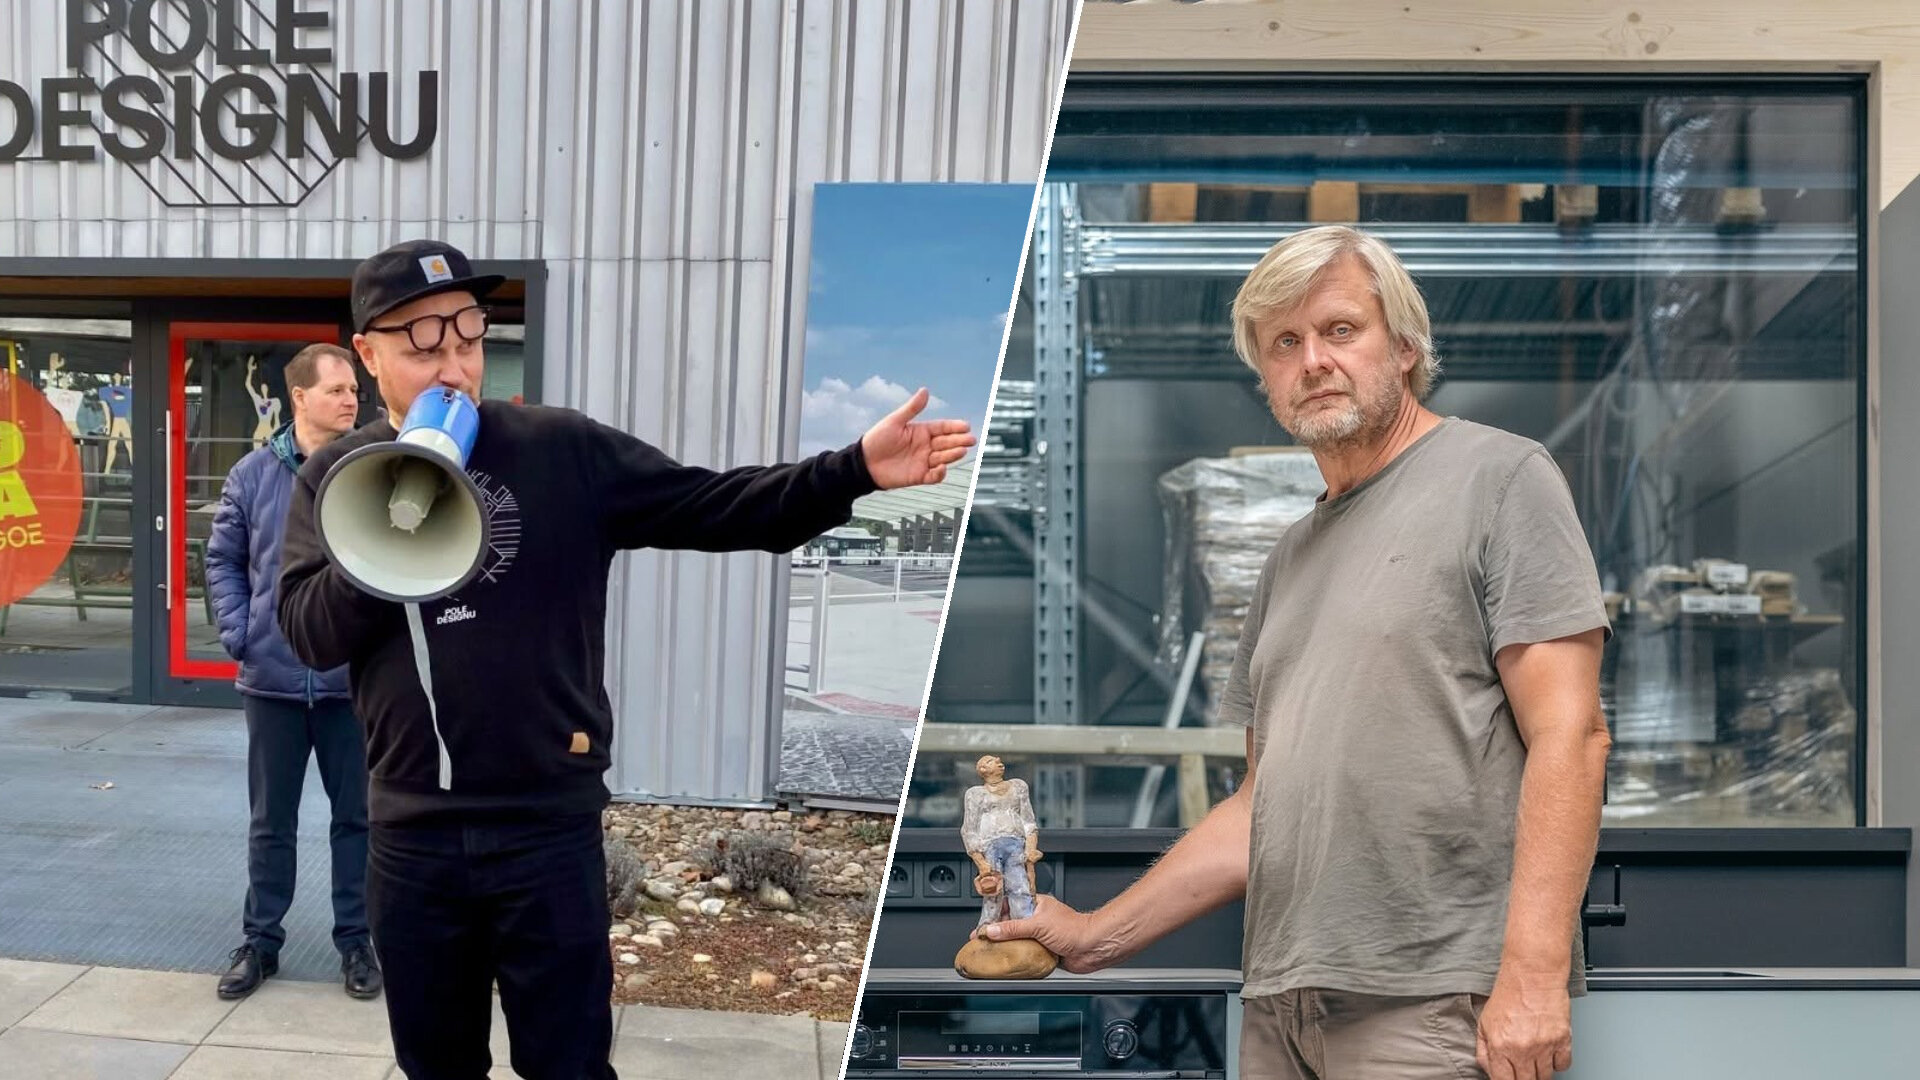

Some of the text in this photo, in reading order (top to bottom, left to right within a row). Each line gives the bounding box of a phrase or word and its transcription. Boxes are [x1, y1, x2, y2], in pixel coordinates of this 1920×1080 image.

[66, 0, 332, 70] POLE
[436, 609, 477, 625] DESIGNU
[444, 605, 468, 617] POLE
